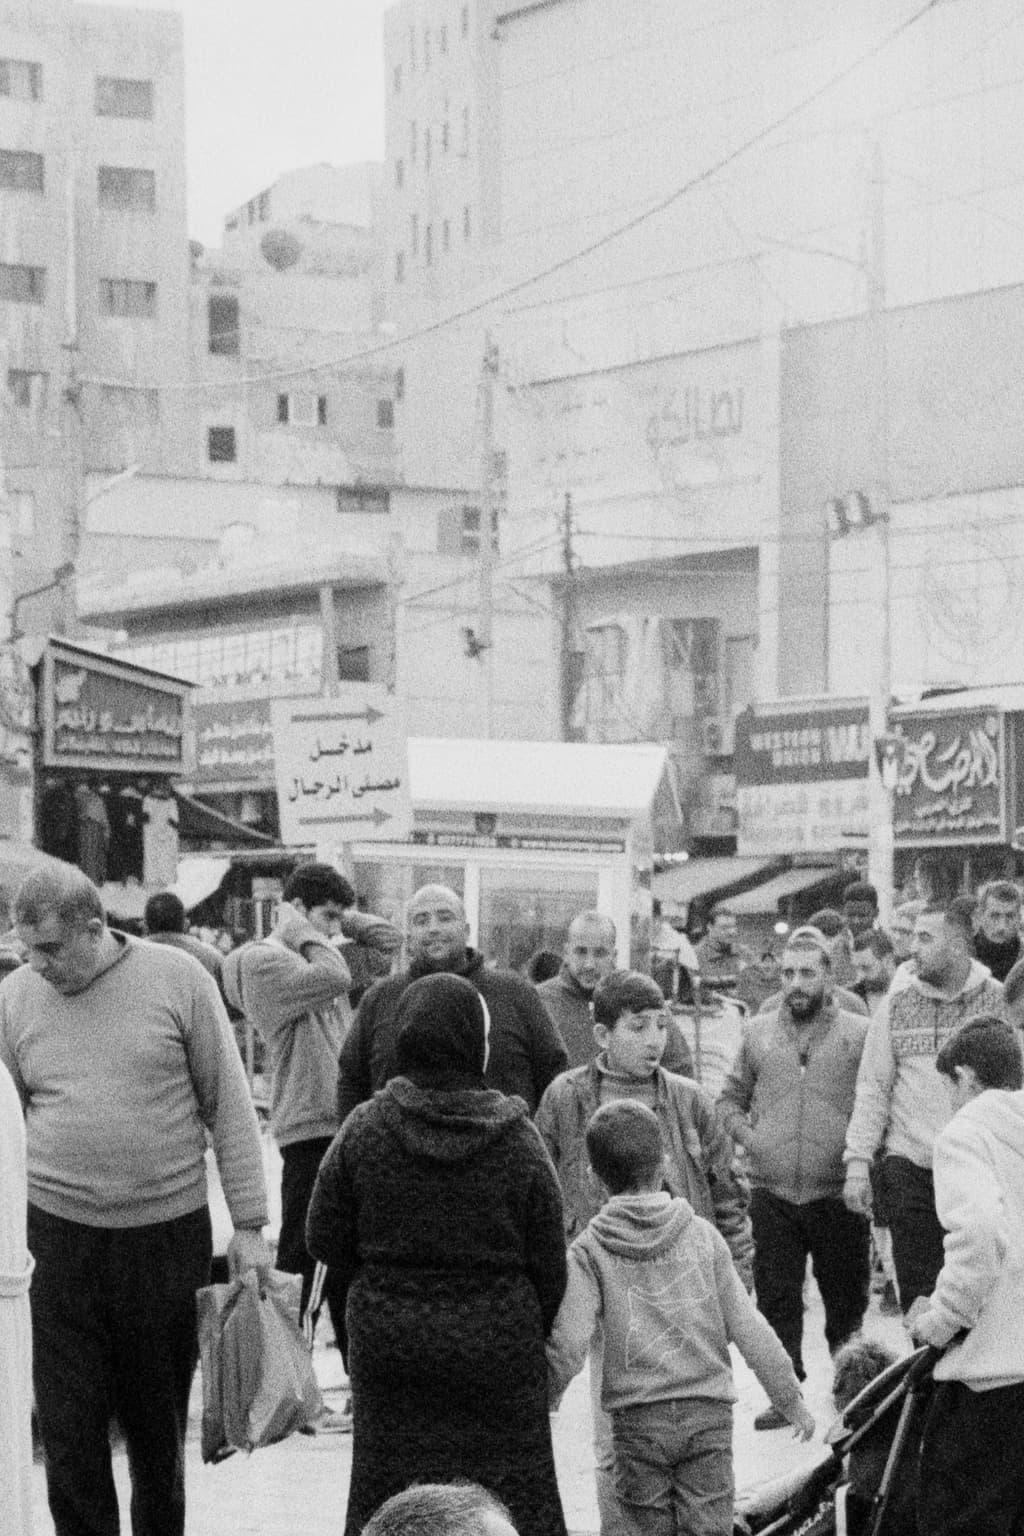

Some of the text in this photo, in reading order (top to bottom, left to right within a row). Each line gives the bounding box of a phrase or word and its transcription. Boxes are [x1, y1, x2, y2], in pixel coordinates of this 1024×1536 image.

[308, 733, 374, 763] مدخل
[288, 775, 401, 804] مصلى الرجال
